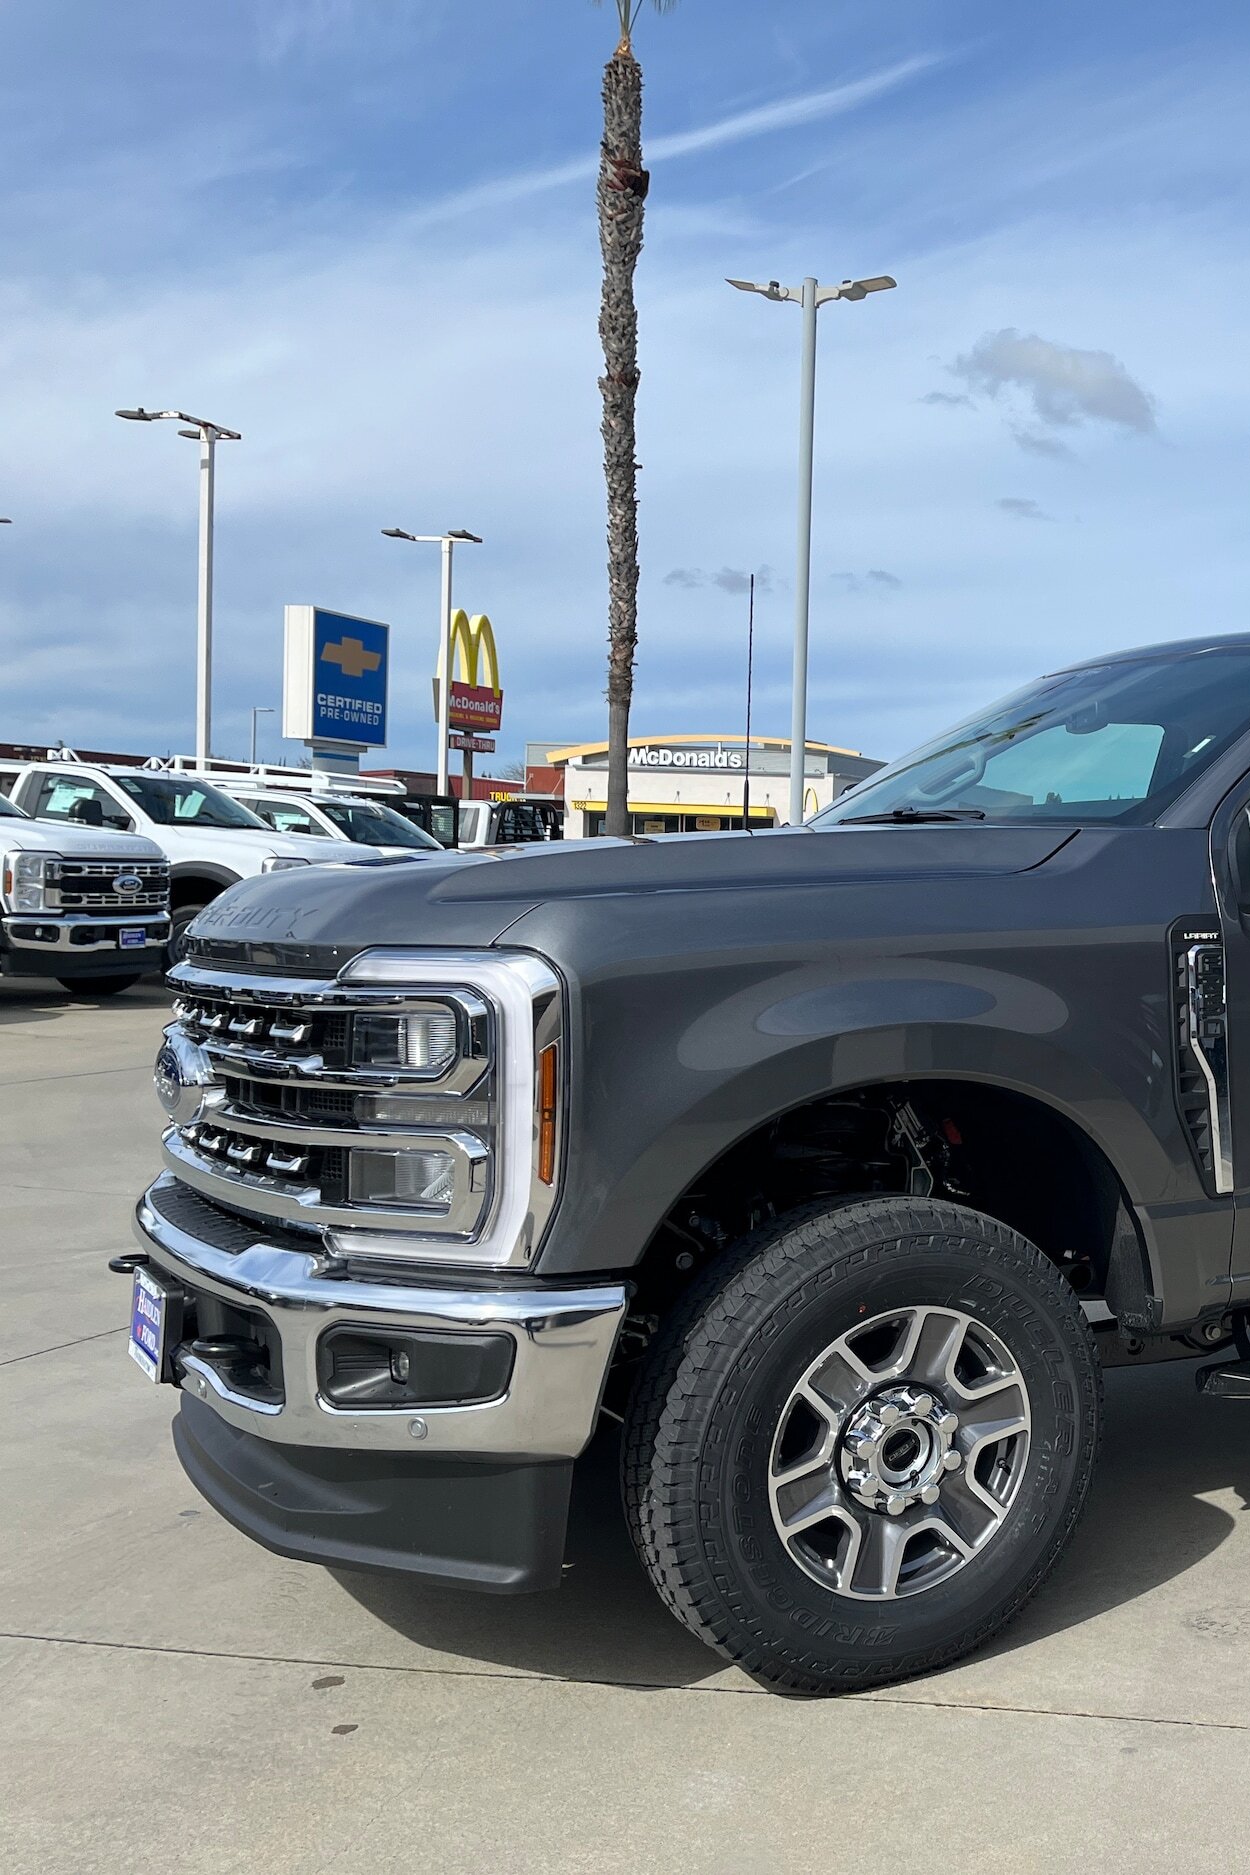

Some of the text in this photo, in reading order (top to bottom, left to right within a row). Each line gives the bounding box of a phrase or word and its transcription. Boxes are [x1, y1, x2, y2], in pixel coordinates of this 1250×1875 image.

[317, 693, 382, 714] CERTIFIED
[447, 695, 500, 714] McDonald's
[320, 706, 379, 725] PRE-OWNED
[456, 736, 495, 751] DRIVE-THRU
[628, 748, 743, 768] McDonald's
